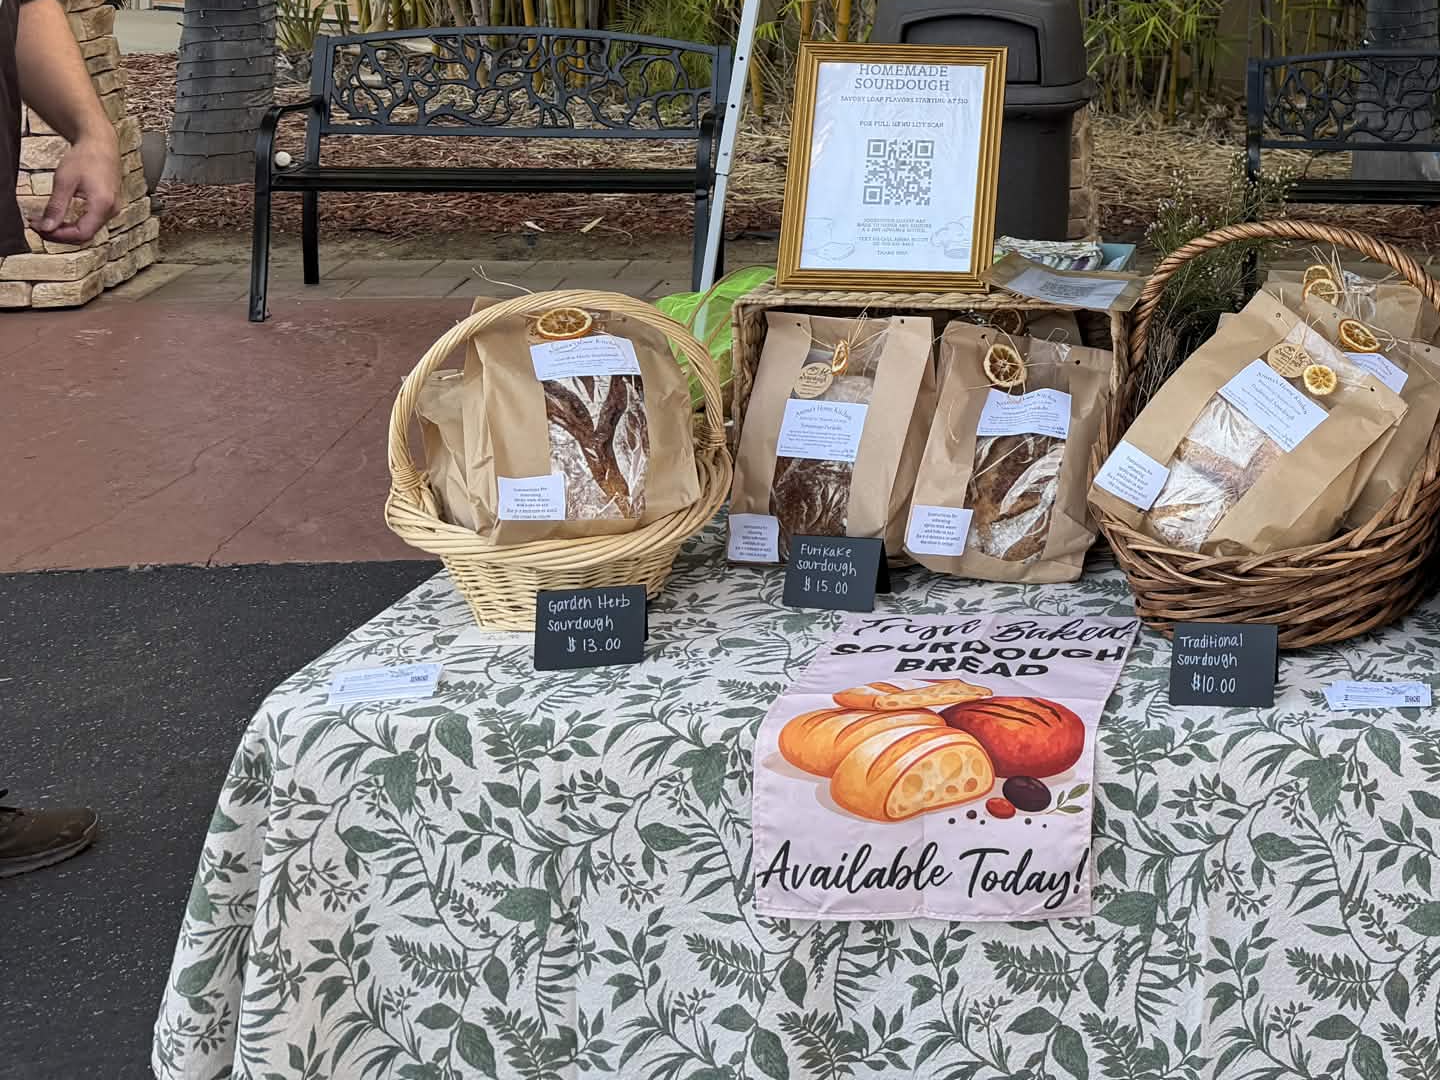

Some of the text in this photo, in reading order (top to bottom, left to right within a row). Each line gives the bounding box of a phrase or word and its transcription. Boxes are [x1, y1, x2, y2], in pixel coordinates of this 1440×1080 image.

[859, 63, 948, 78] HOMEMADE
[854, 78, 950, 91] SOURDOUGH
[800, 543, 852, 558] Furikake
[548, 593, 631, 615] Garden Herb
[990, 617, 1133, 643] Baked
[1179, 632, 1243, 649] Traditional
[830, 640, 1126, 663] SOURDOUGH
[893, 657, 1050, 678] BREAD
[755, 838, 1091, 911] Available Today!
